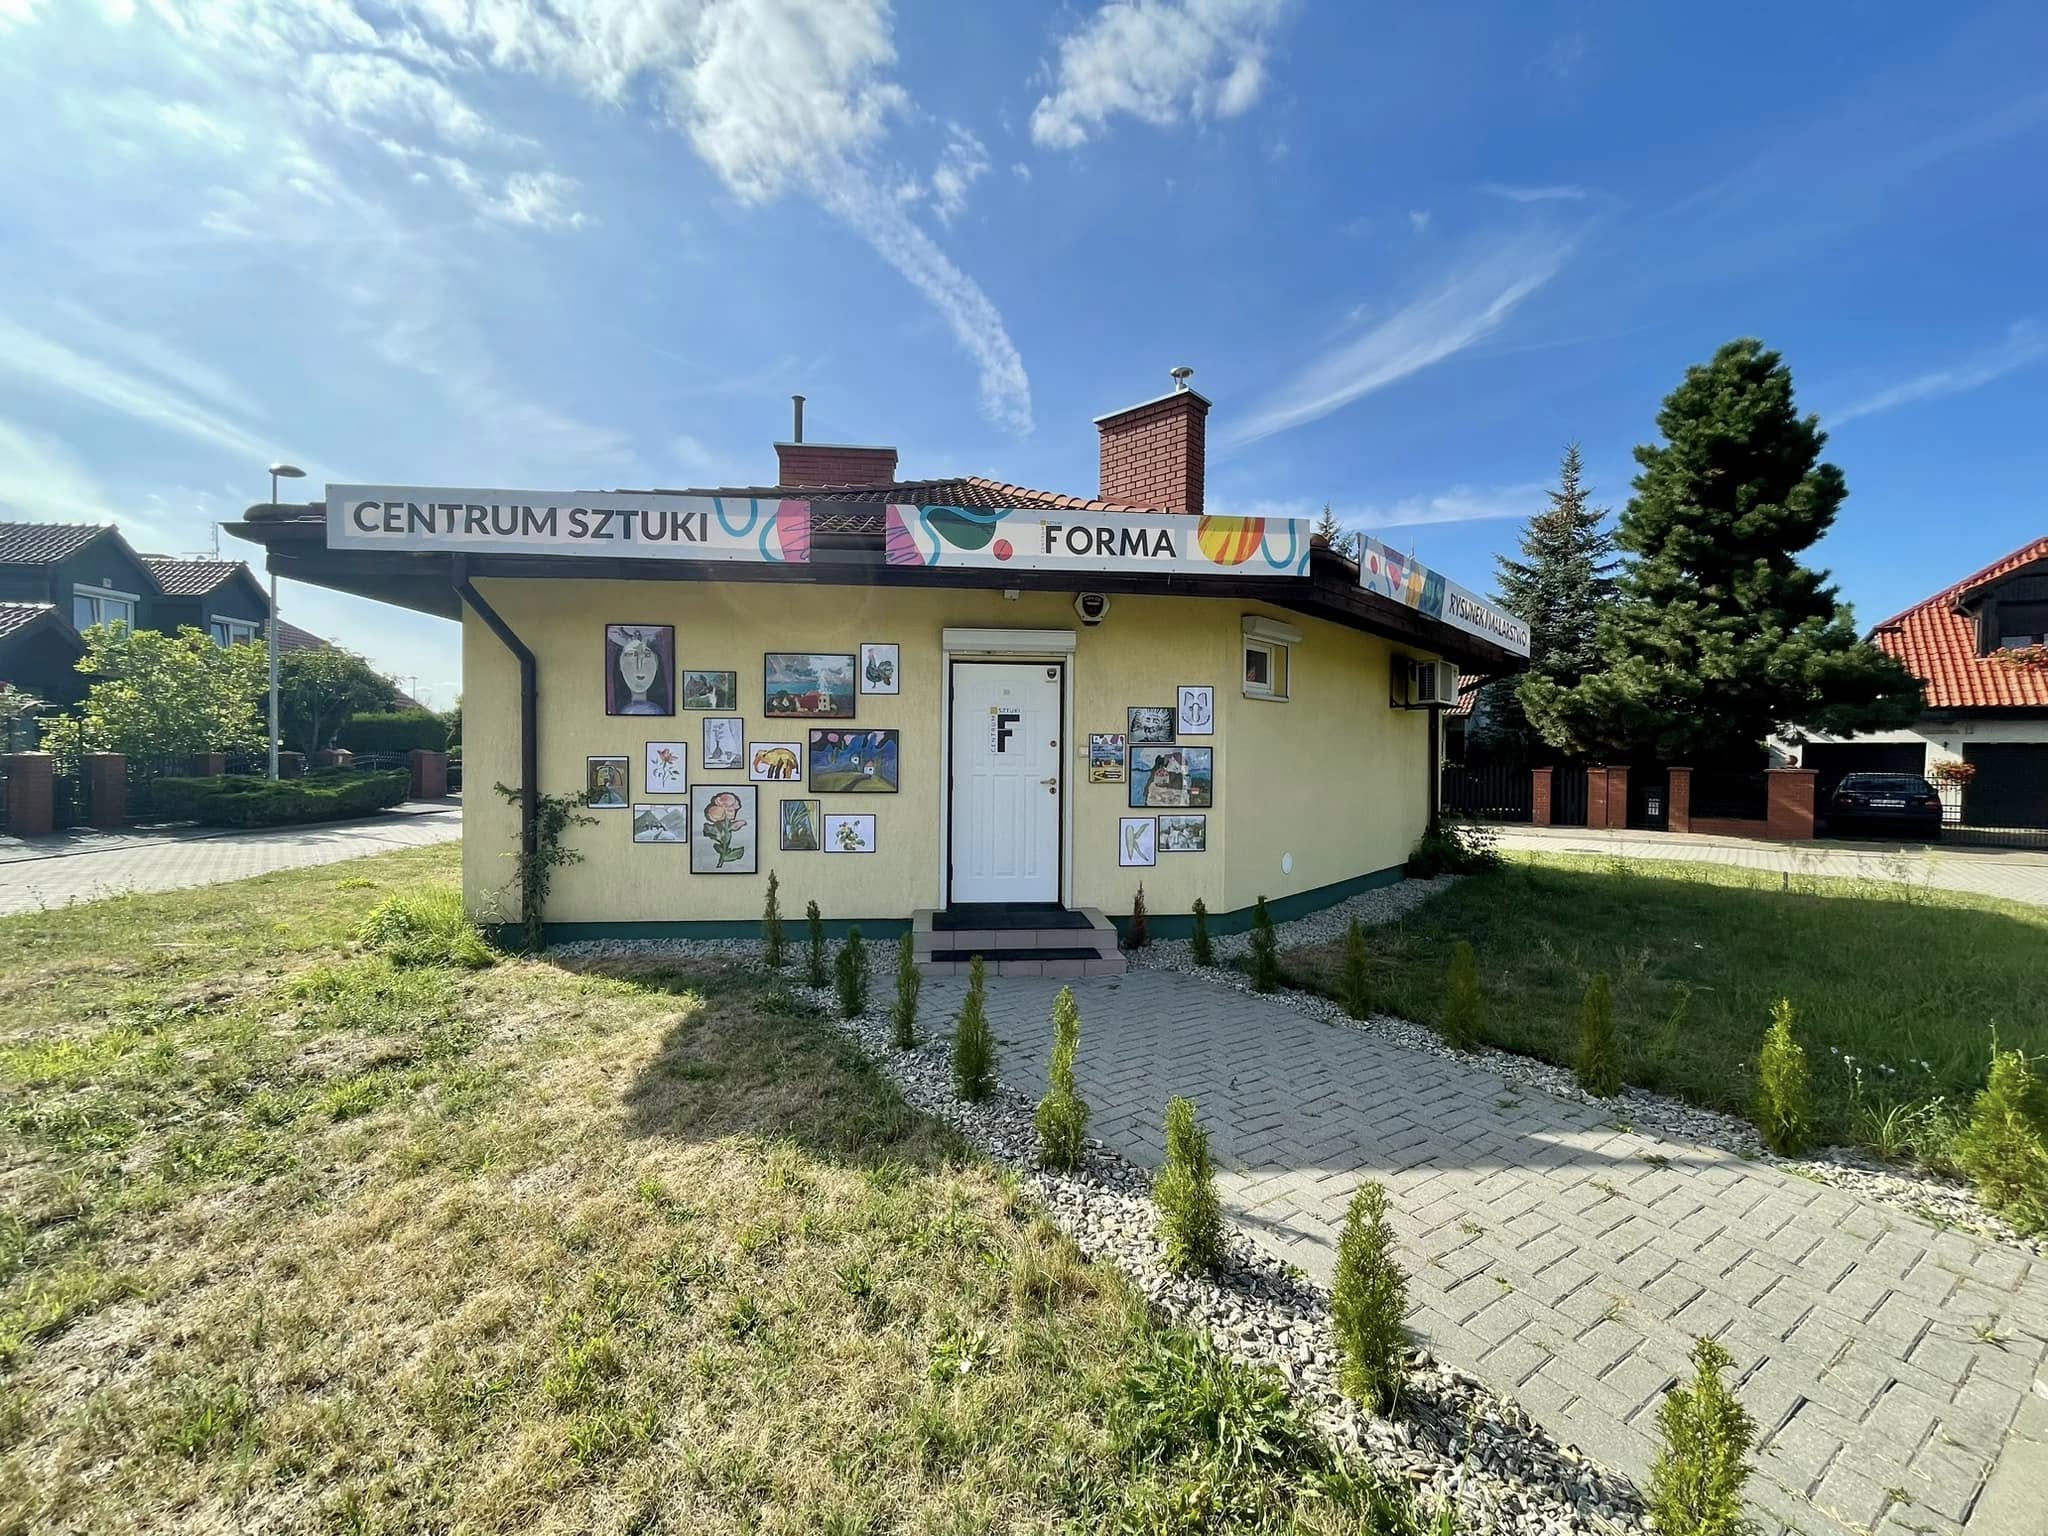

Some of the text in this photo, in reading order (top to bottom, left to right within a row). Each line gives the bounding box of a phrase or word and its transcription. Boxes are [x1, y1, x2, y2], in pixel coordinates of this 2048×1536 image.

[353, 501, 708, 542] CENTRUM SZTUKI
[1045, 525, 1177, 558] FORMA
[1449, 592, 1485, 628] RYSUNEK
[997, 714, 1020, 752] F
